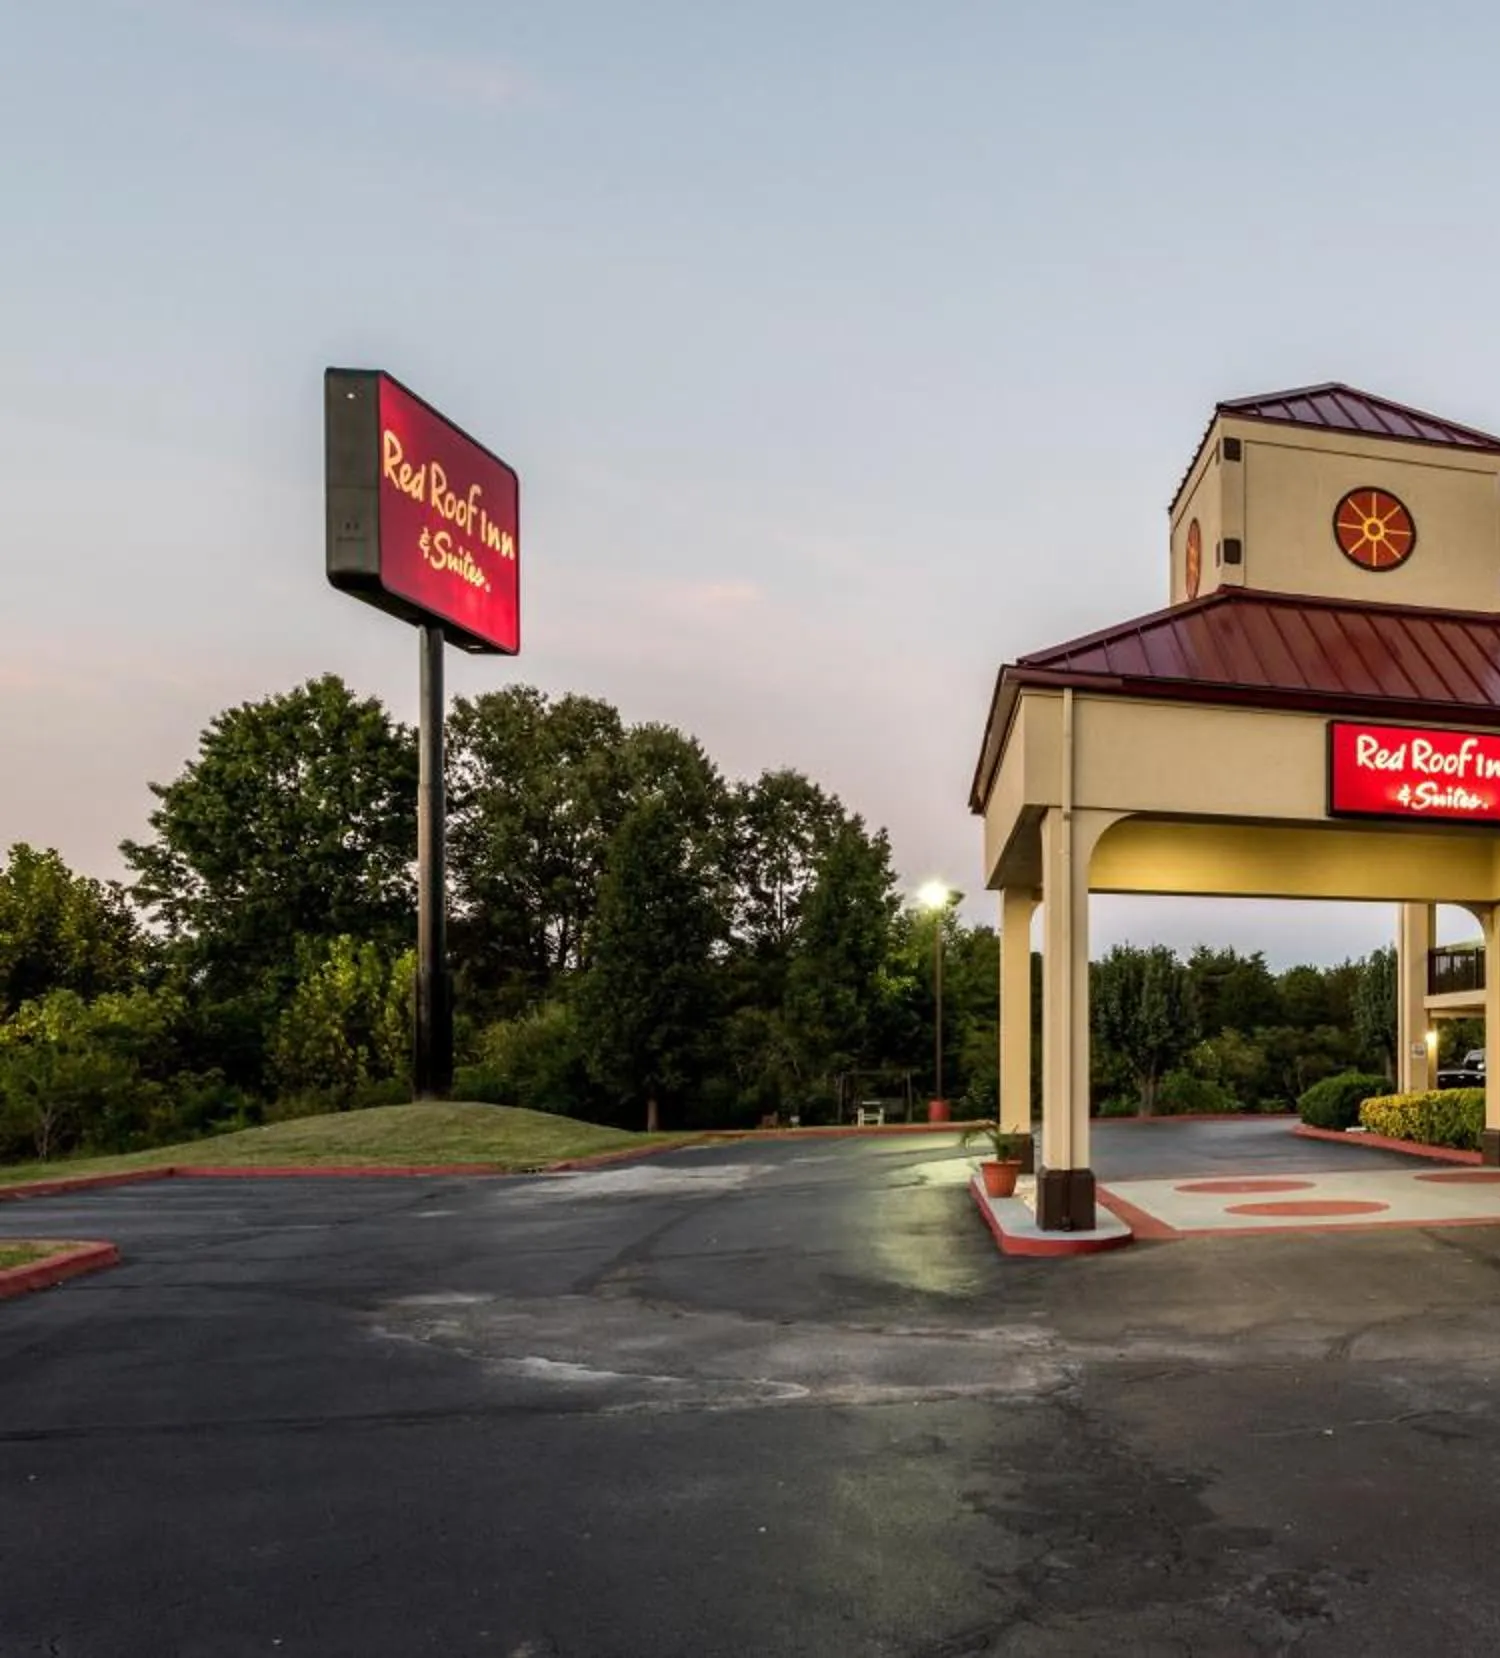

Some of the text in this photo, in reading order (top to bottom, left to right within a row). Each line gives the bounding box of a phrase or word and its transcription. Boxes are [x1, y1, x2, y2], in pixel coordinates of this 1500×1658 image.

[383, 429, 515, 560] Red Roof Inn
[1356, 734, 1407, 771] Red
[1411, 737, 1479, 778] Roof
